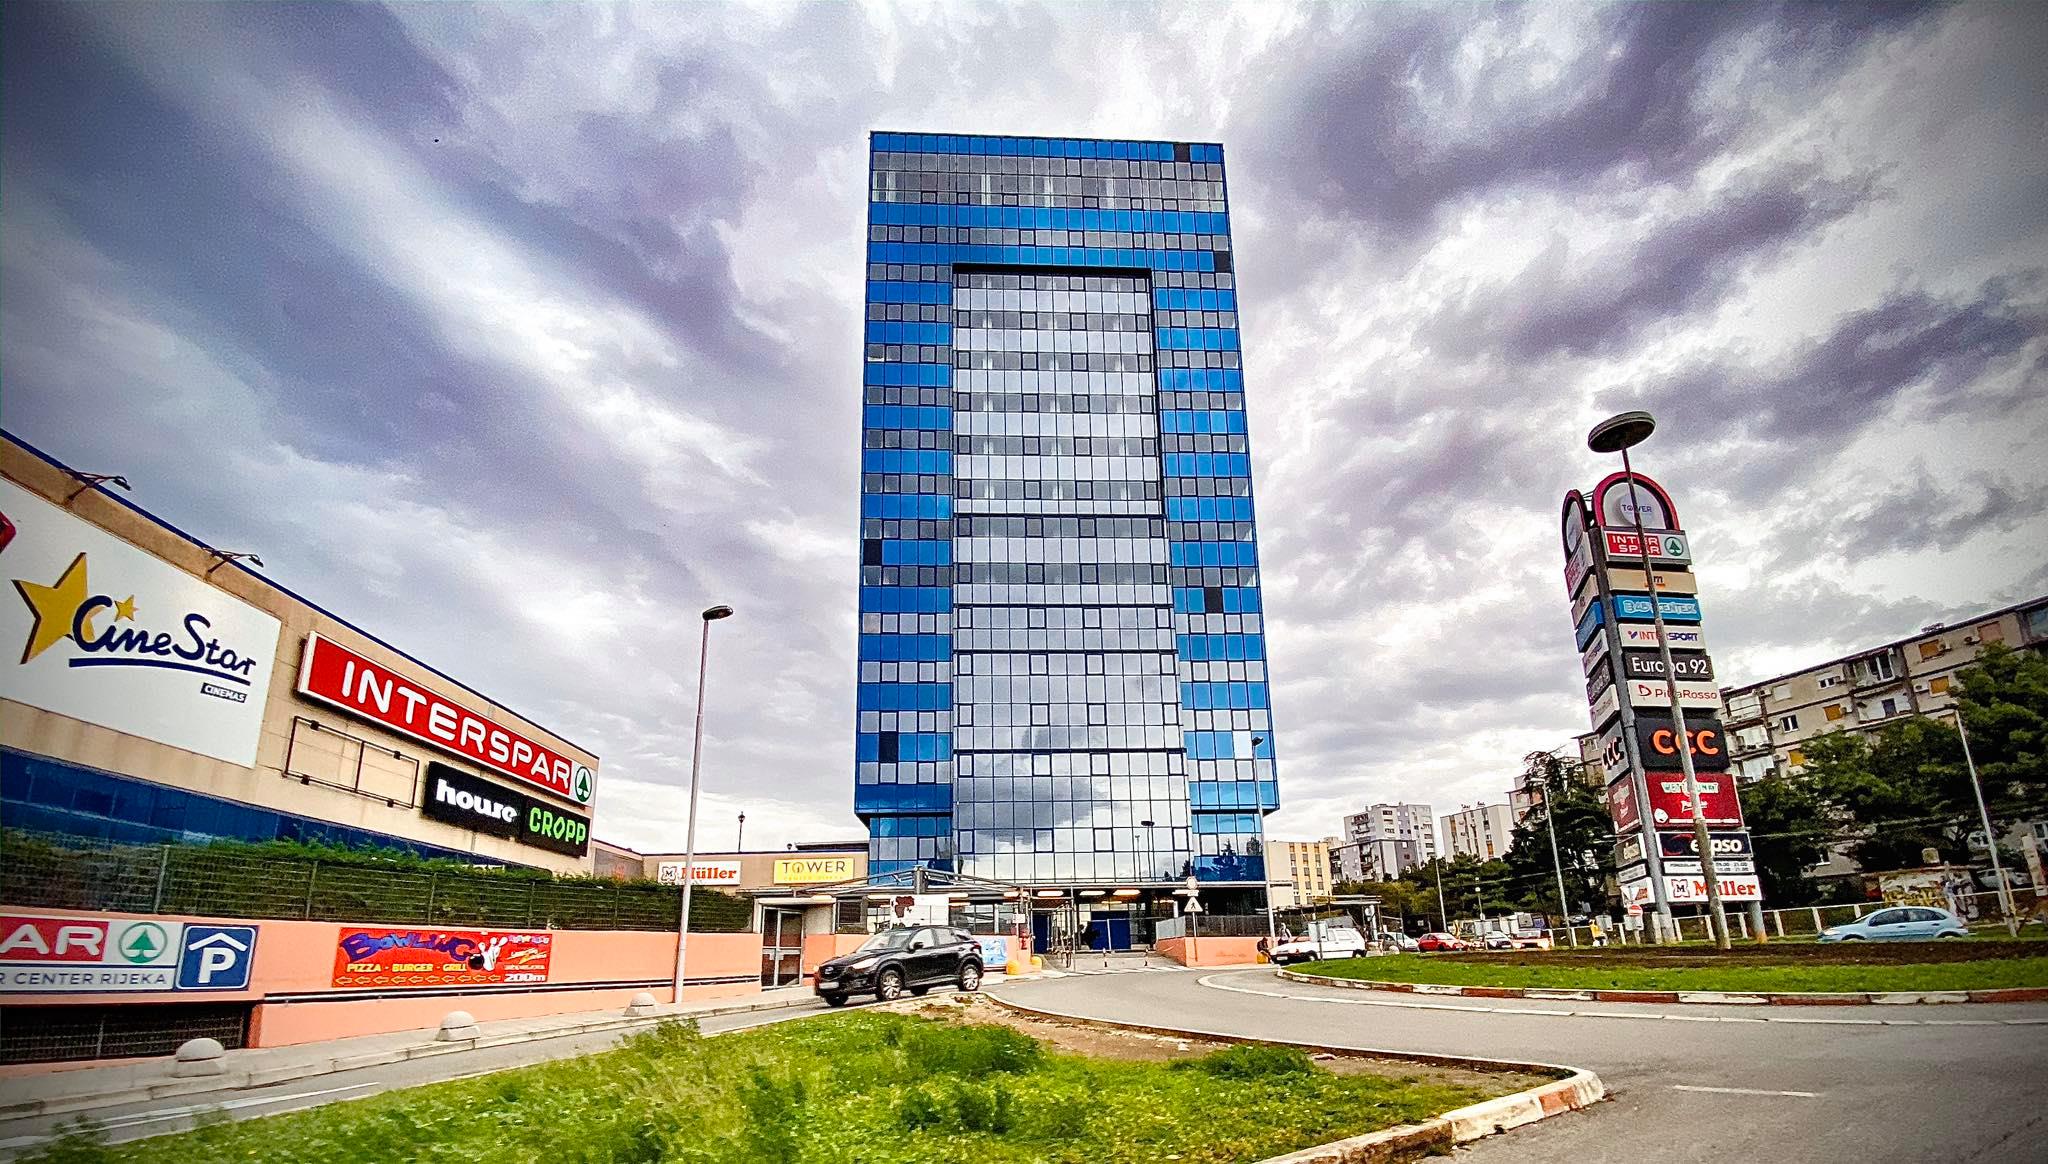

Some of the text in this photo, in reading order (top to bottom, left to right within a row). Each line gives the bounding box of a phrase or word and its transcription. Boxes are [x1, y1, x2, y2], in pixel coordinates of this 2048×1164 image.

[1621, 504, 1652, 513] TOER
[73, 595, 256, 675] CineStar
[1639, 631, 1698, 641] INTSPORT
[1690, 659, 1709, 674] 92
[204, 684, 246, 702] CINEMAS
[1655, 688, 1718, 700] PiaRosso
[341, 660, 570, 790] INTERSPAR
[435, 778, 518, 823] house
[529, 806, 587, 845] CROPP
[1690, 838, 1743, 856] epso
[681, 867, 737, 880] Müller
[782, 860, 846, 873] TOWER
[198, 948, 236, 984] P
[346, 963, 382, 972] PIZZA
[392, 963, 433, 972] BURGER
[15, 973, 94, 985] CENTER
[100, 973, 167, 985] RIJEKA
